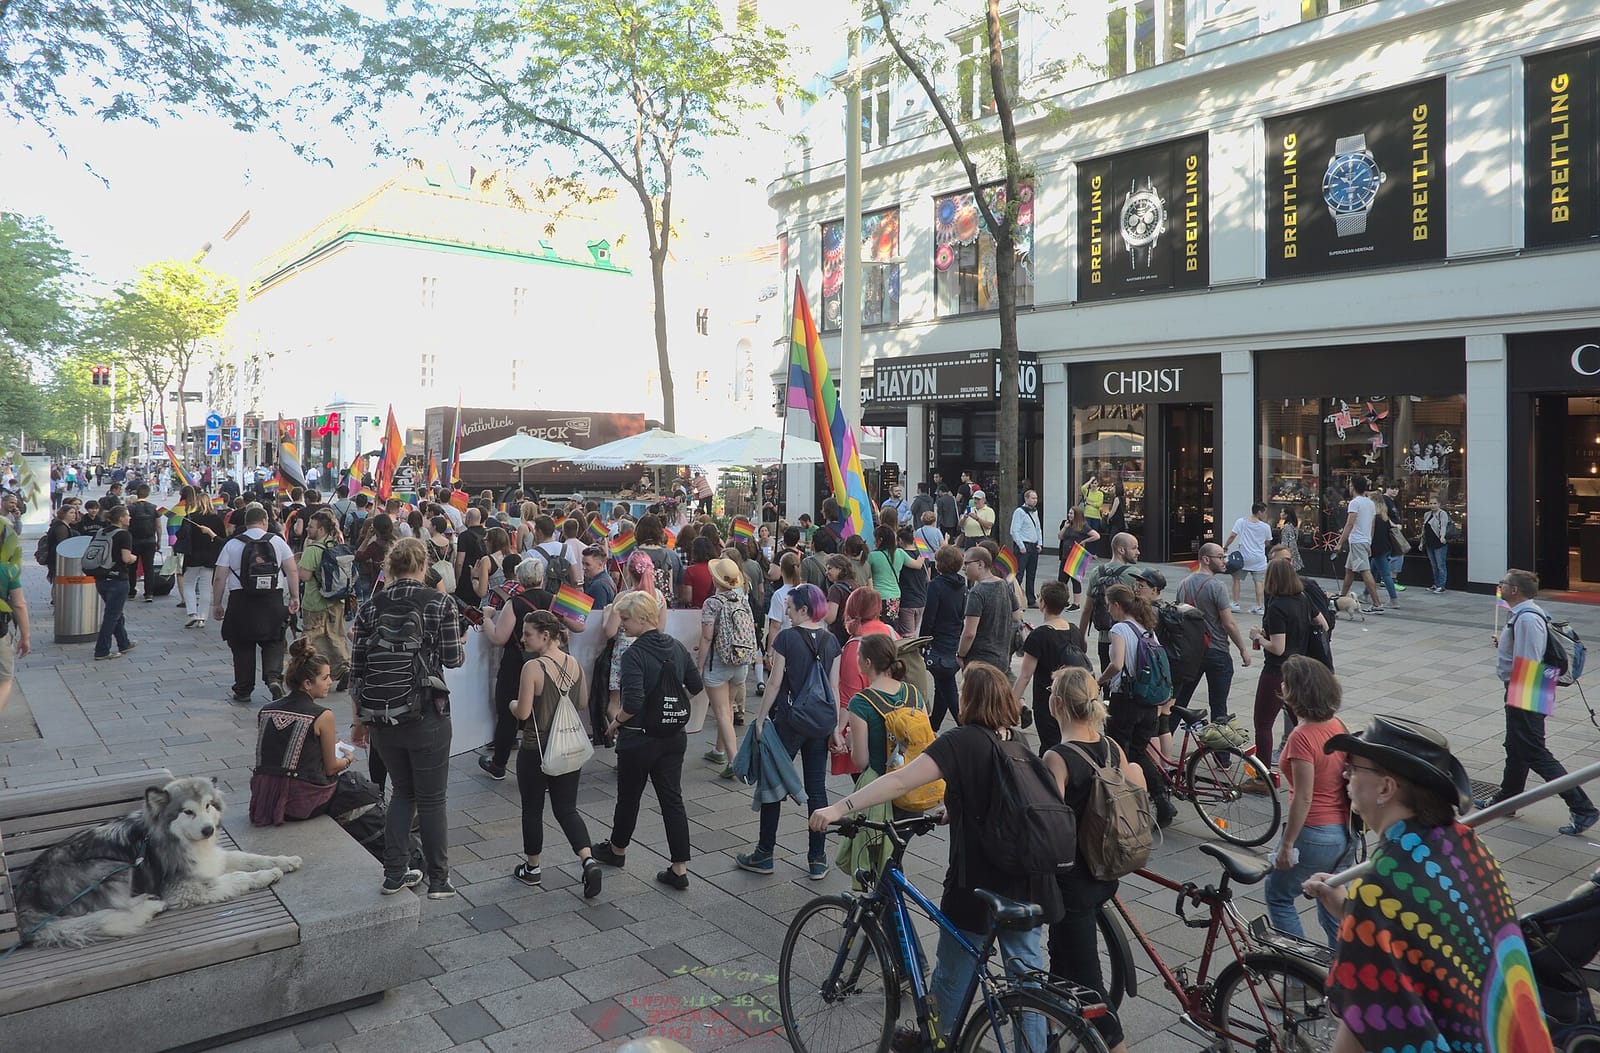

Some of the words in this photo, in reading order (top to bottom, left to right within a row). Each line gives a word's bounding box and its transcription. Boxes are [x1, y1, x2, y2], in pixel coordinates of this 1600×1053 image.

[1283, 132, 1298, 258] BREITLING
[1412, 104, 1429, 240] BREITLING
[1551, 73, 1570, 222] BREITLING
[1090, 175, 1102, 283] BREITLING
[1186, 154, 1199, 271] BREITLING
[876, 368, 937, 397] HAYDN
[1103, 367, 1184, 395] CHRIST
